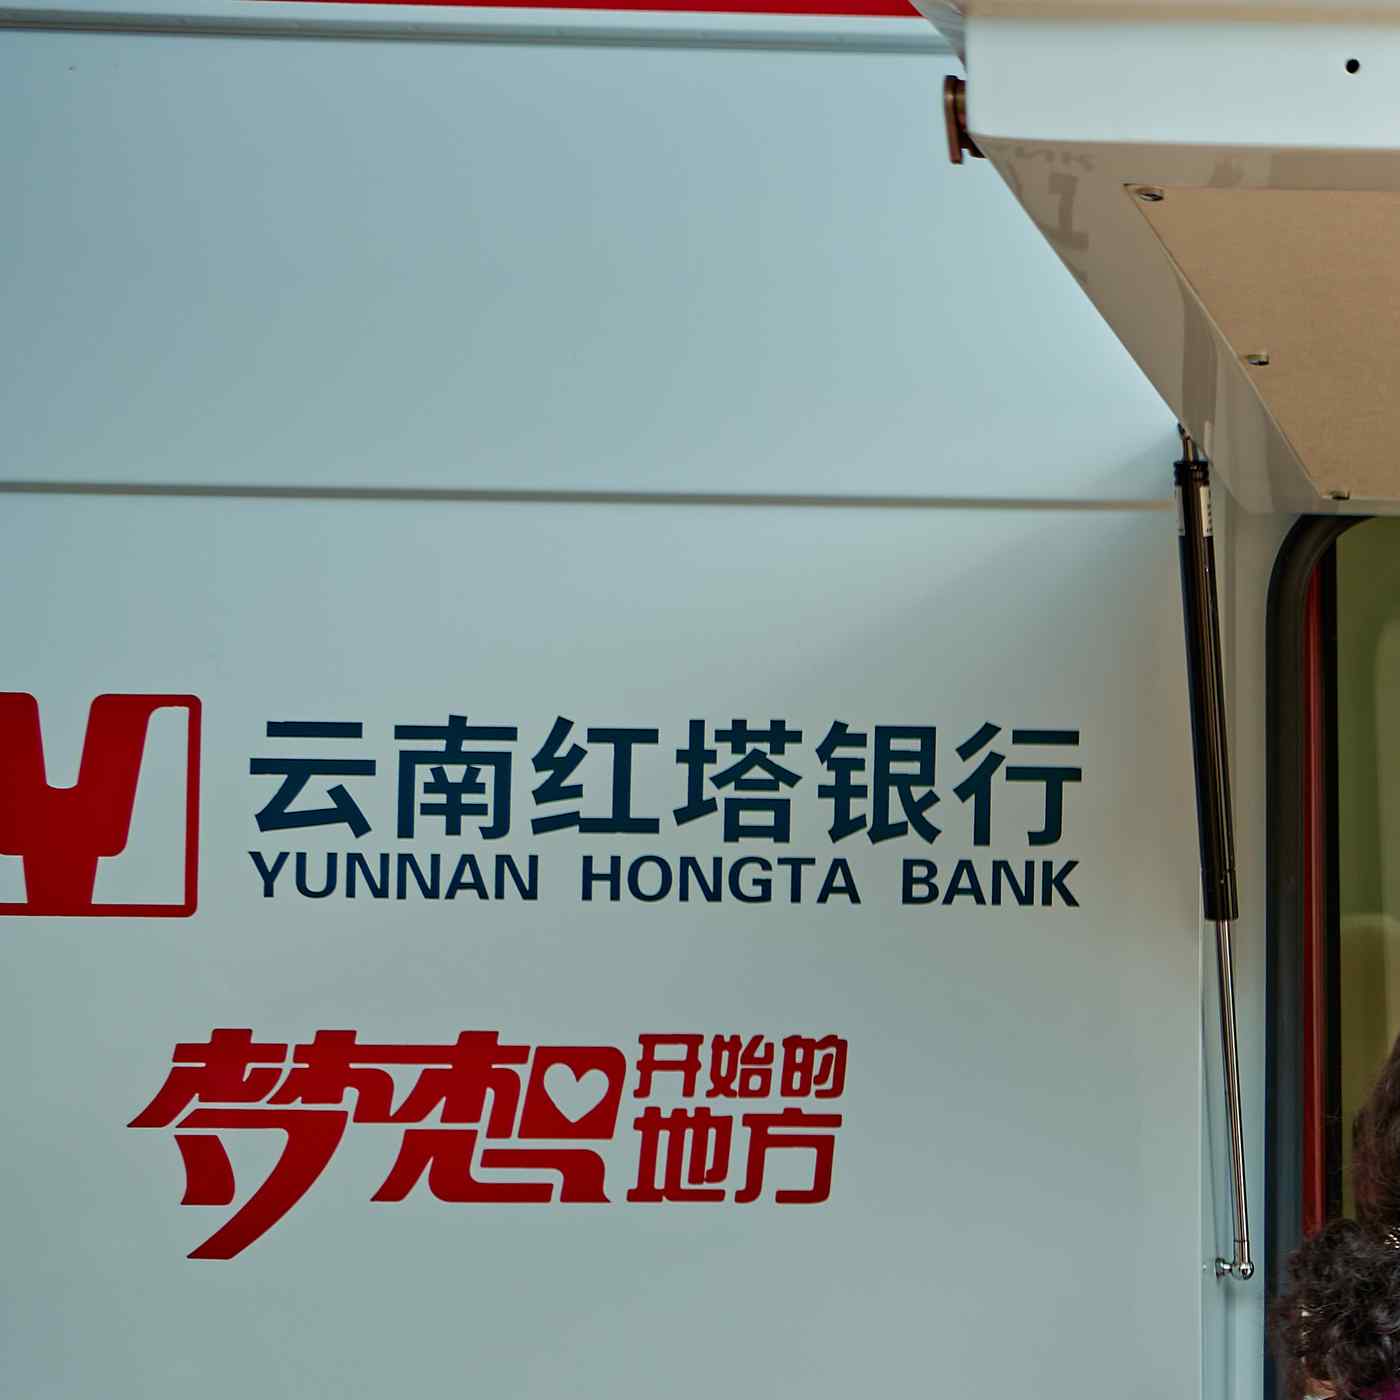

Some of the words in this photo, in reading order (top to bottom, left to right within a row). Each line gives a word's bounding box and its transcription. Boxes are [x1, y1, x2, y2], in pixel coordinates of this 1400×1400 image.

[249, 714, 1083, 847] 云南红塔银行
[248, 850, 540, 901] YUNNAN
[581, 853, 862, 905] HONGTA
[901, 858, 1081, 907] BANK
[634, 1033, 849, 1099] 开始的
[127, 1028, 628, 1260] 梦想
[626, 1106, 842, 1204] 地方
